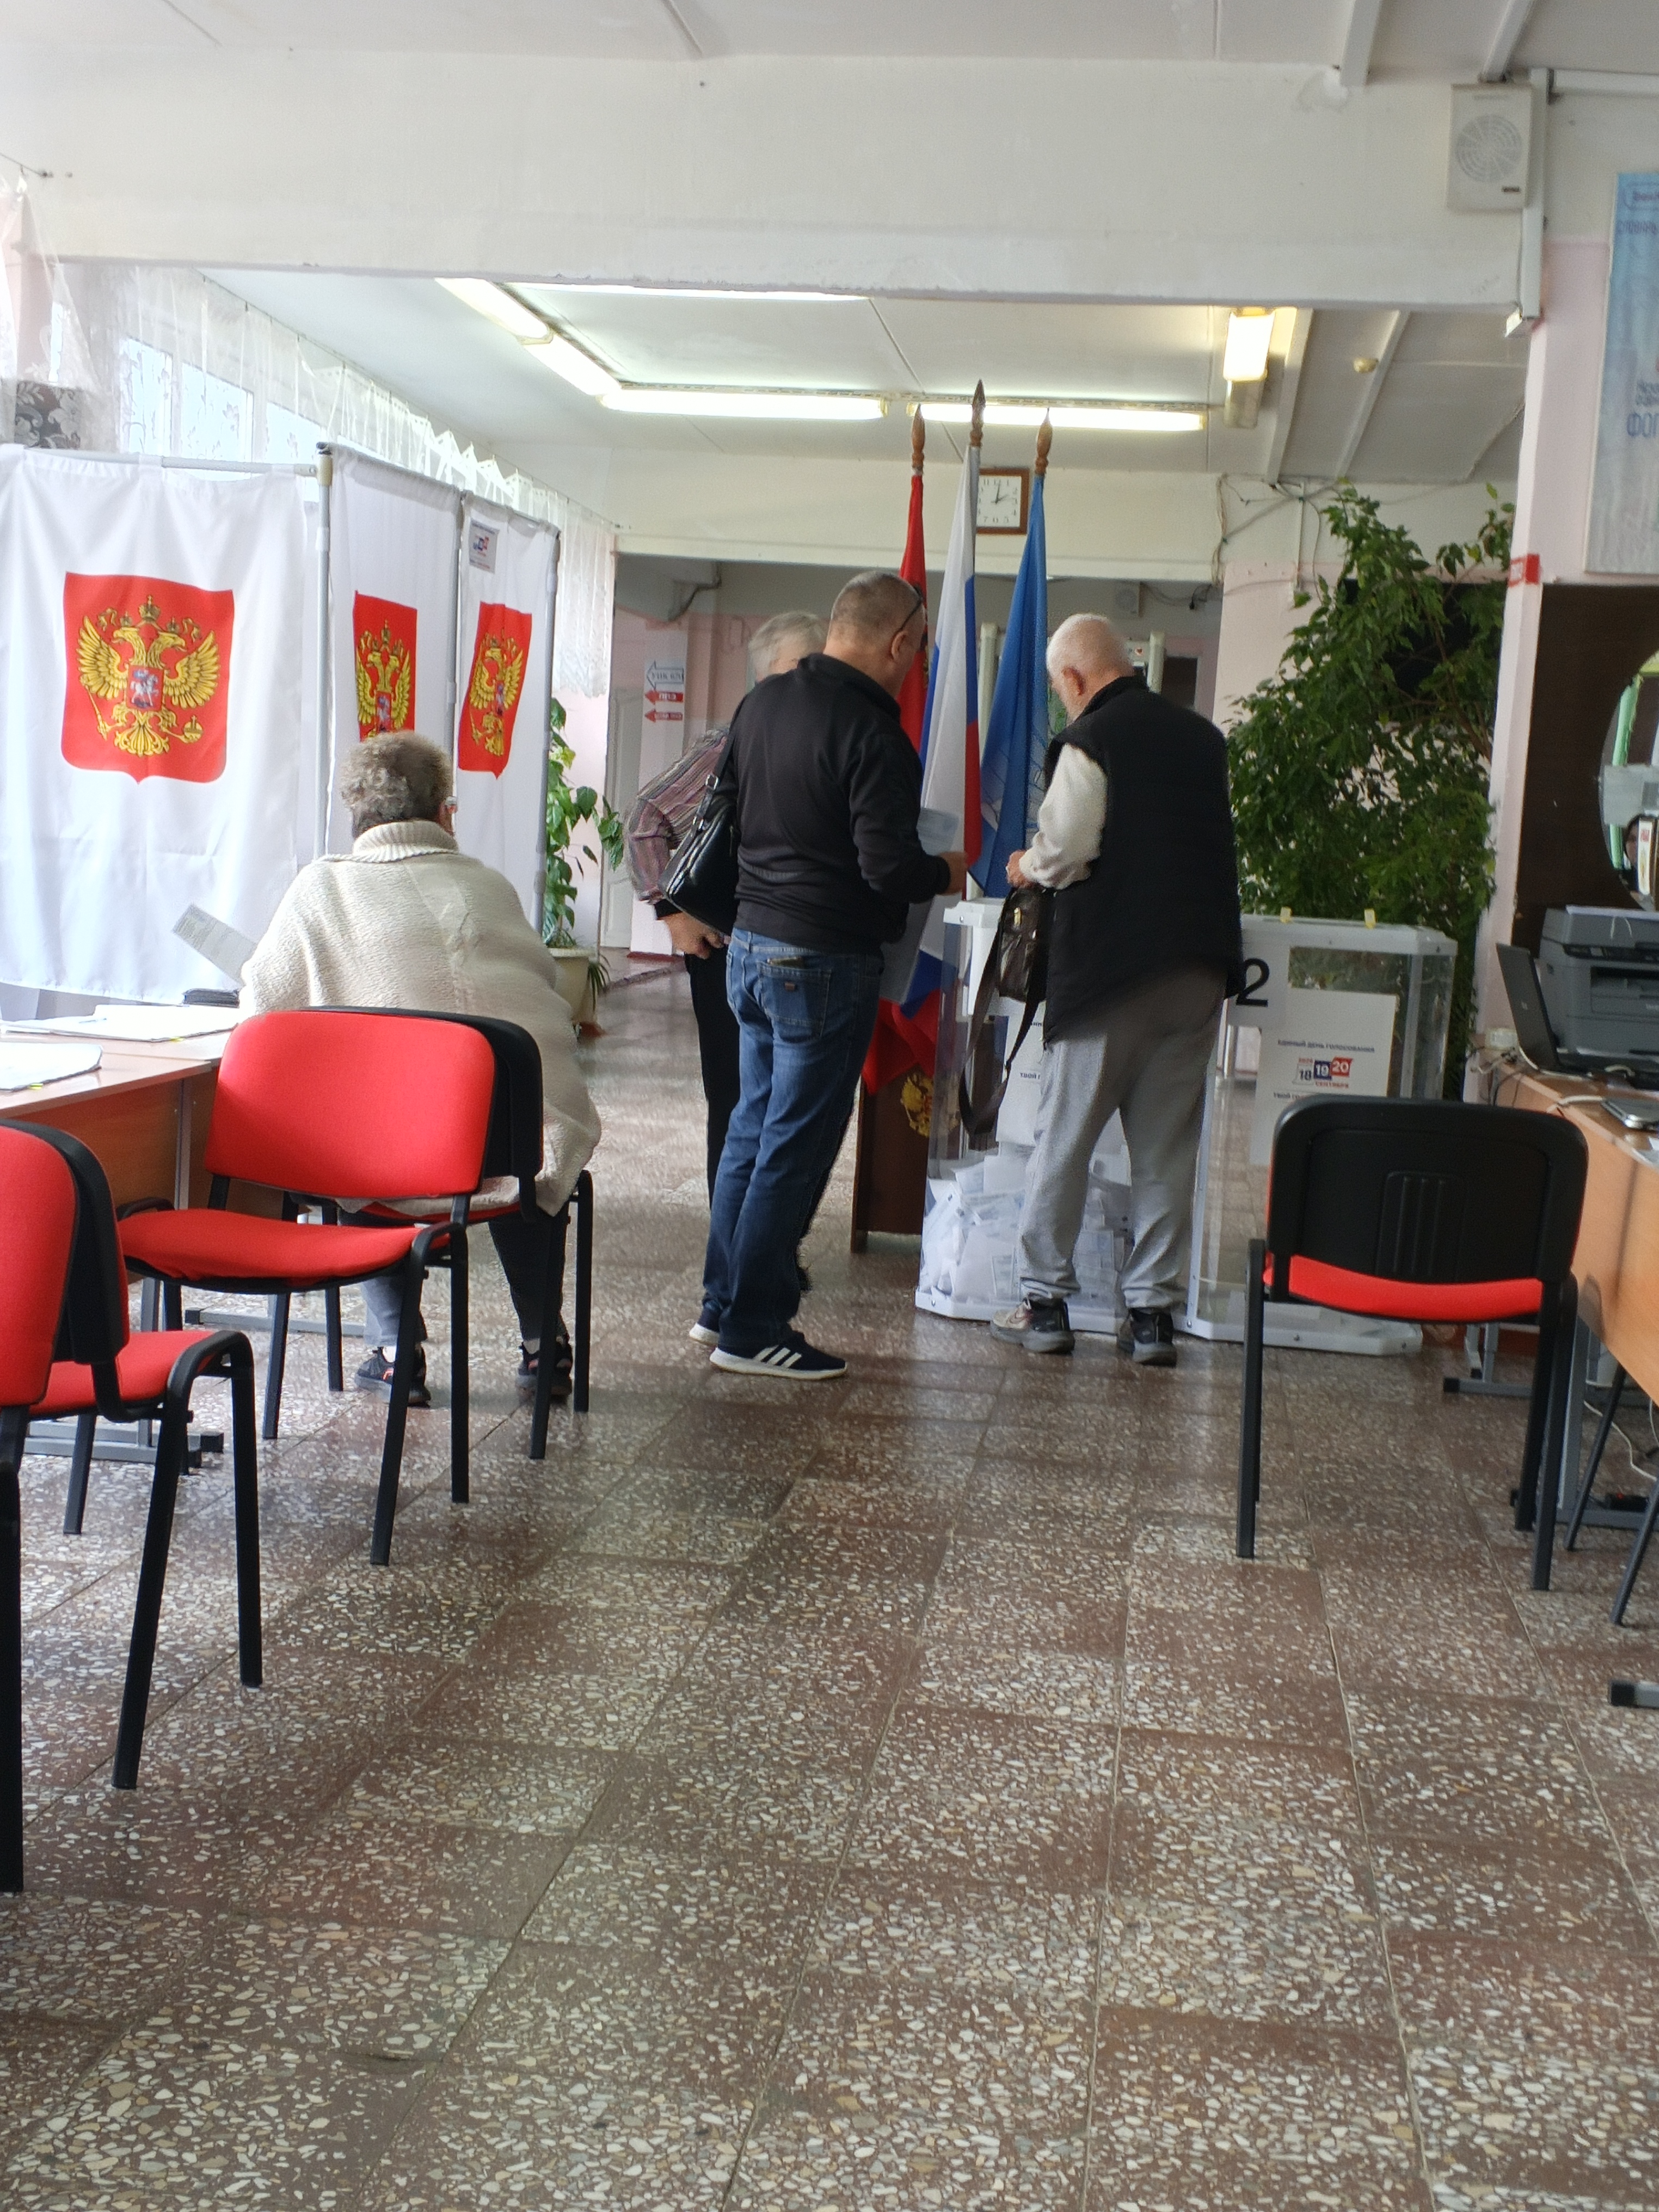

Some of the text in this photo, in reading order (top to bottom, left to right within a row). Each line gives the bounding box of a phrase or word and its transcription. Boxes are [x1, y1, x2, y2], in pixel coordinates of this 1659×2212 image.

[1236, 958, 1269, 1007] 2
[1300, 1070, 1312, 1081] 18
[1332, 1061, 1349, 1073] 20
